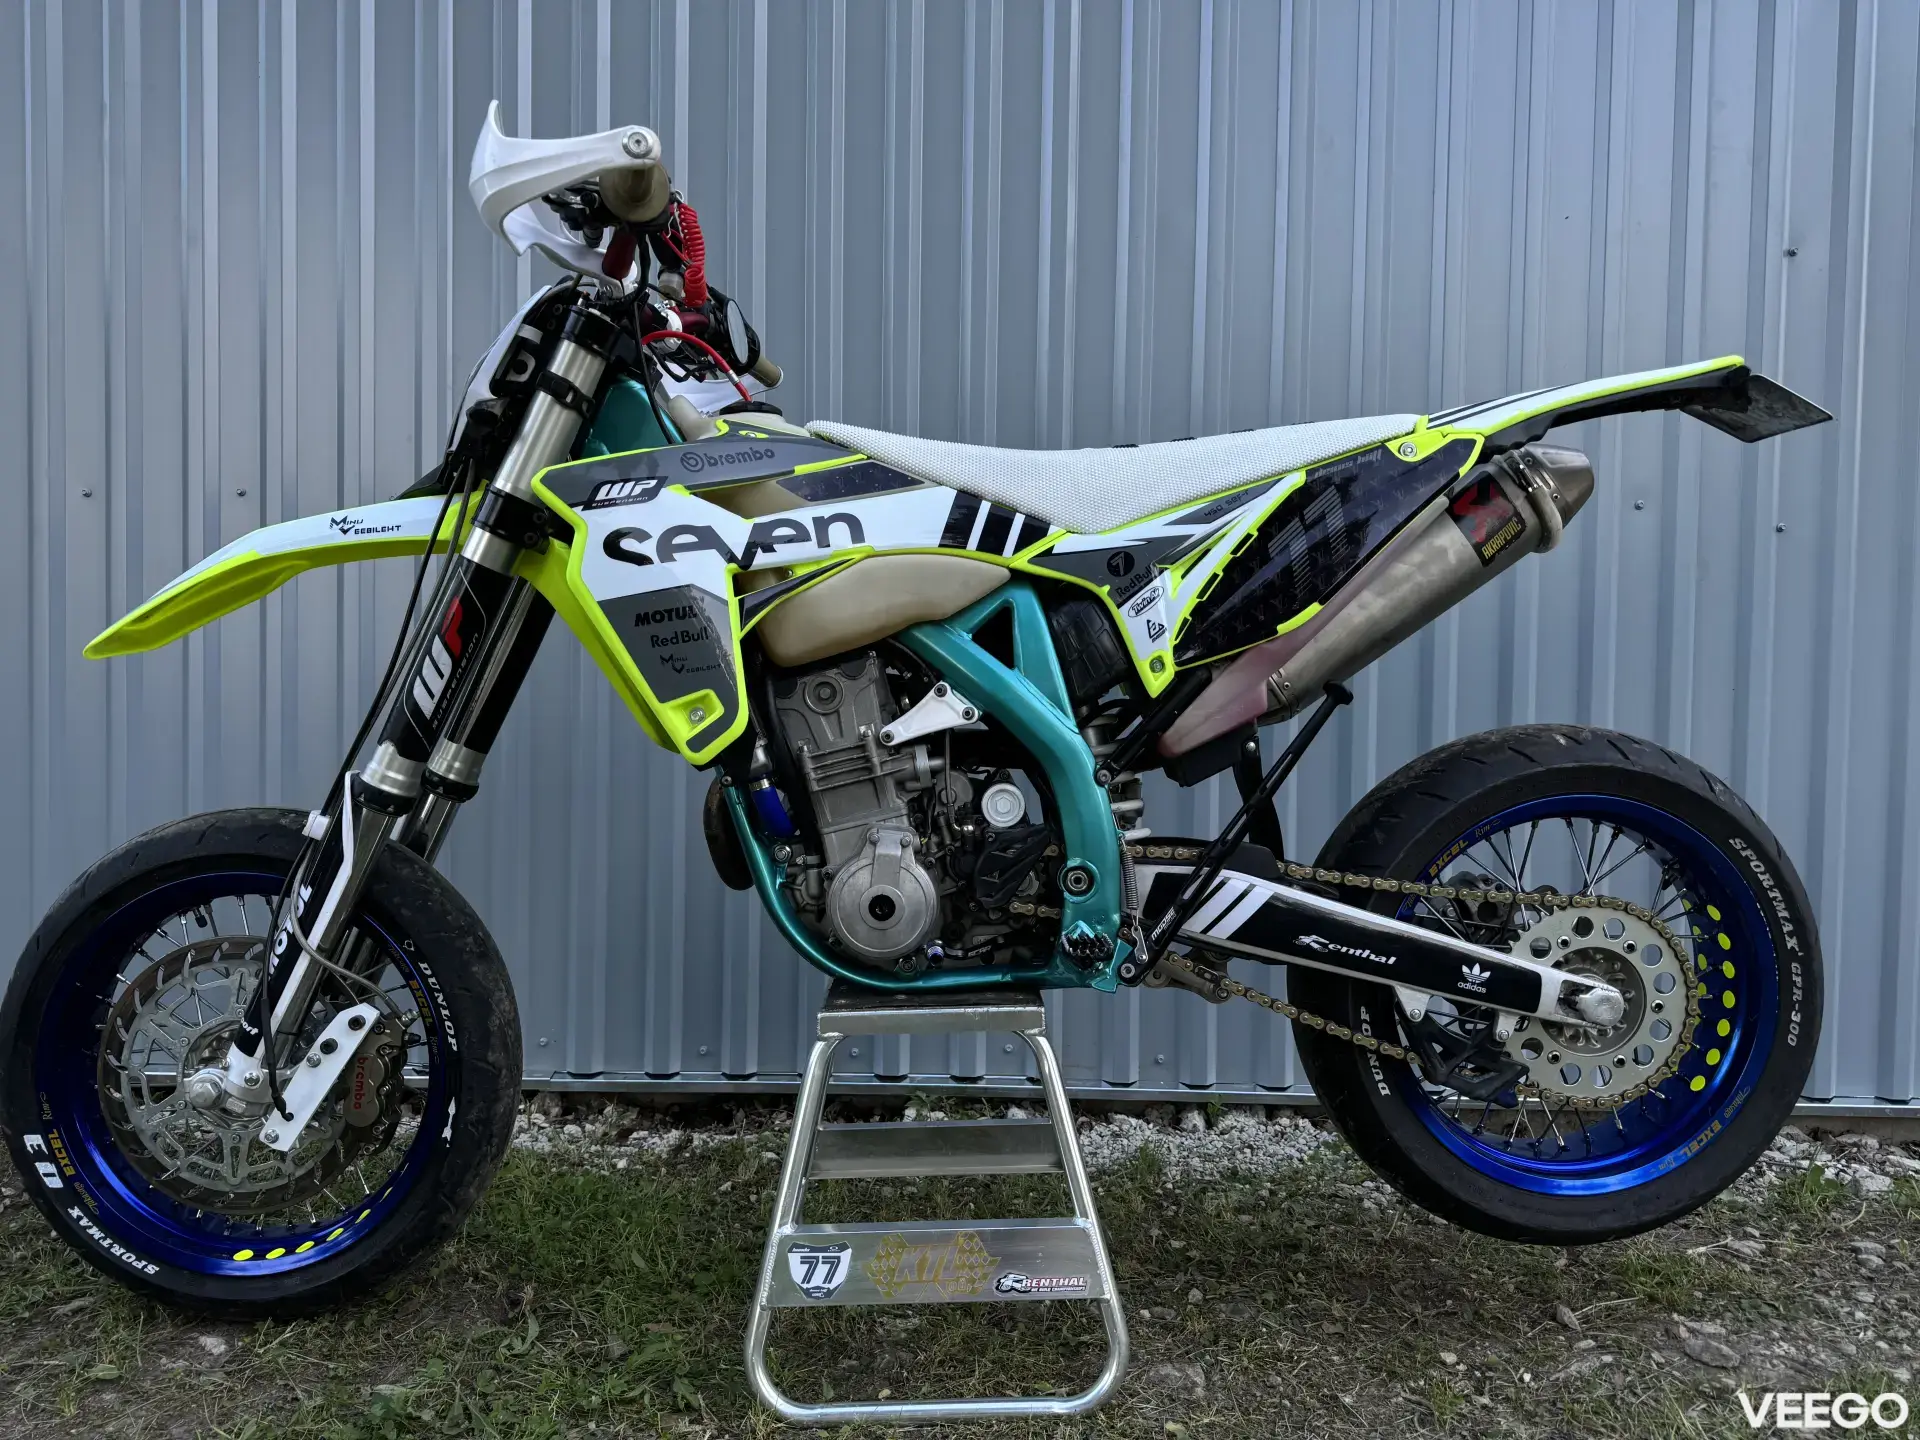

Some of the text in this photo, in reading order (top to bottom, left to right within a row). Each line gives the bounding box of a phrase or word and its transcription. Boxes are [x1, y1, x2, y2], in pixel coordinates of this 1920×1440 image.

[703, 446, 775, 467] brembo
[595, 480, 658, 500] WP
[634, 605, 698, 627] MOTUL
[1428, 839, 1469, 877] EXCEL
[1729, 837, 1802, 1047] SPORTMAX GPR-300
[408, 979, 433, 1027] EXCEL
[418, 961, 458, 1052] DUNLOP
[1457, 981, 1487, 994] adidas
[1360, 1005, 1391, 1096] DUNOP
[353, 1056, 369, 1110] brembo
[48, 1128, 76, 1177] EXCEL
[1680, 1120, 1722, 1157] EXCEL
[67, 1206, 160, 1275] SPORTMAX
[800, 1255, 841, 1284] 77
[1021, 1277, 1087, 1288] RENTHAL
